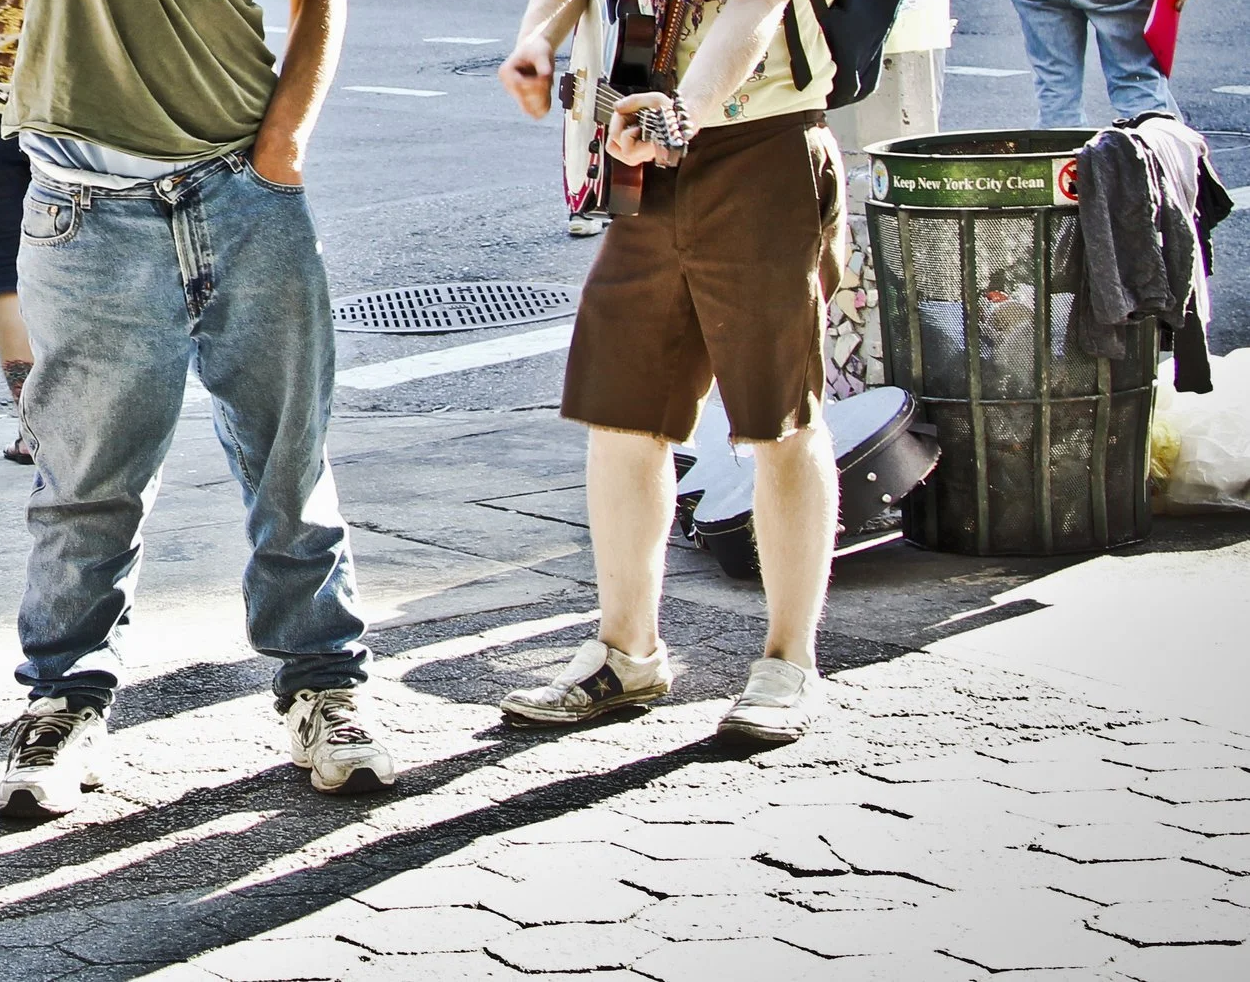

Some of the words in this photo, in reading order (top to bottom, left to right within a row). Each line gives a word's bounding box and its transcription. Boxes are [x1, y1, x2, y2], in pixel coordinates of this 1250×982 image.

[893, 175, 916, 192] Keep
[917, 176, 941, 190] New
[943, 177, 975, 191] York
[975, 177, 1004, 193] City
[1006, 176, 1045, 189] Clean
